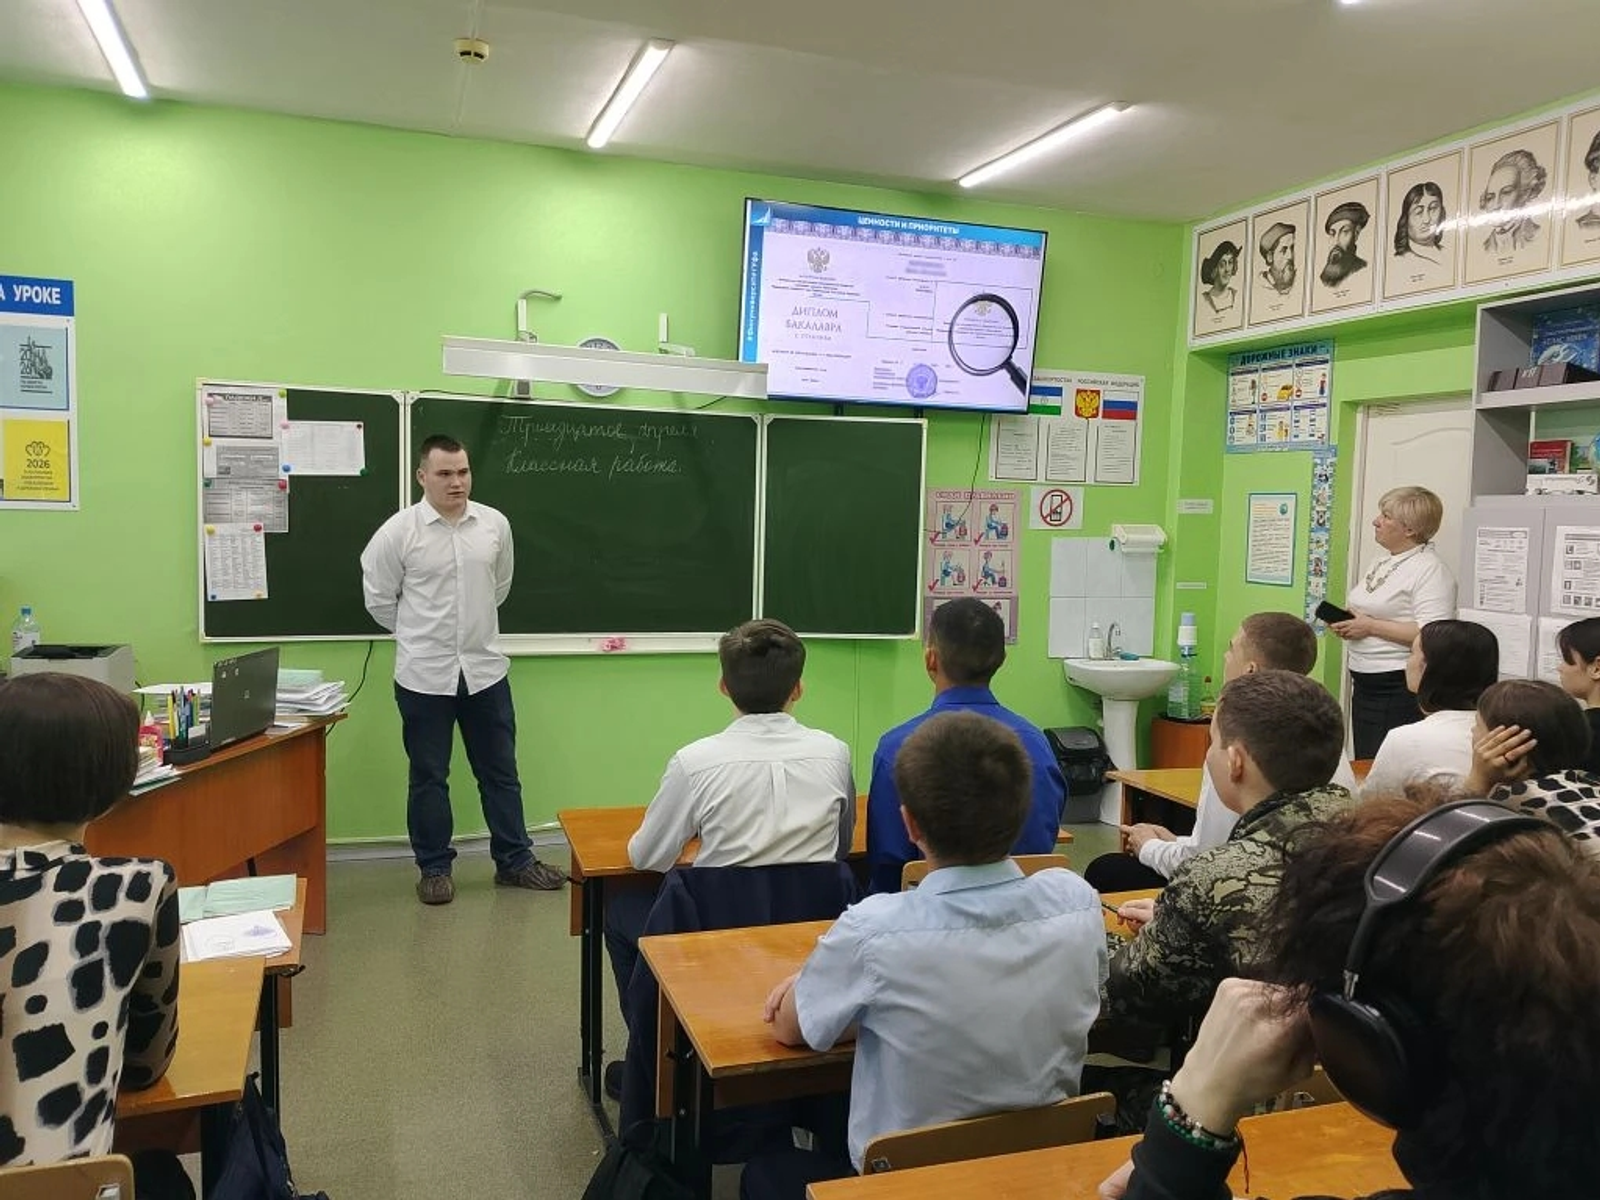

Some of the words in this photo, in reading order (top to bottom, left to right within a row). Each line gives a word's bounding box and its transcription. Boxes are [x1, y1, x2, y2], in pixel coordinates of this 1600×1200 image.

[858, 215, 901, 228] ЦЕННОСТИ
[901, 220, 907, 229] И
[909, 221, 960, 235] ПРИОРИТЕТЫ
[13, 284, 62, 305] УРОКЕ
[791, 305, 839, 319] ДИПЛОМ
[786, 319, 842, 333] БАКАЛАВРА
[1240, 349, 1286, 366] ДОРОЖНЫЕ
[1288, 344, 1318, 358] ЗНАКИ
[26, 458, 51, 469] 2026
[504, 448, 602, 475] Классная
